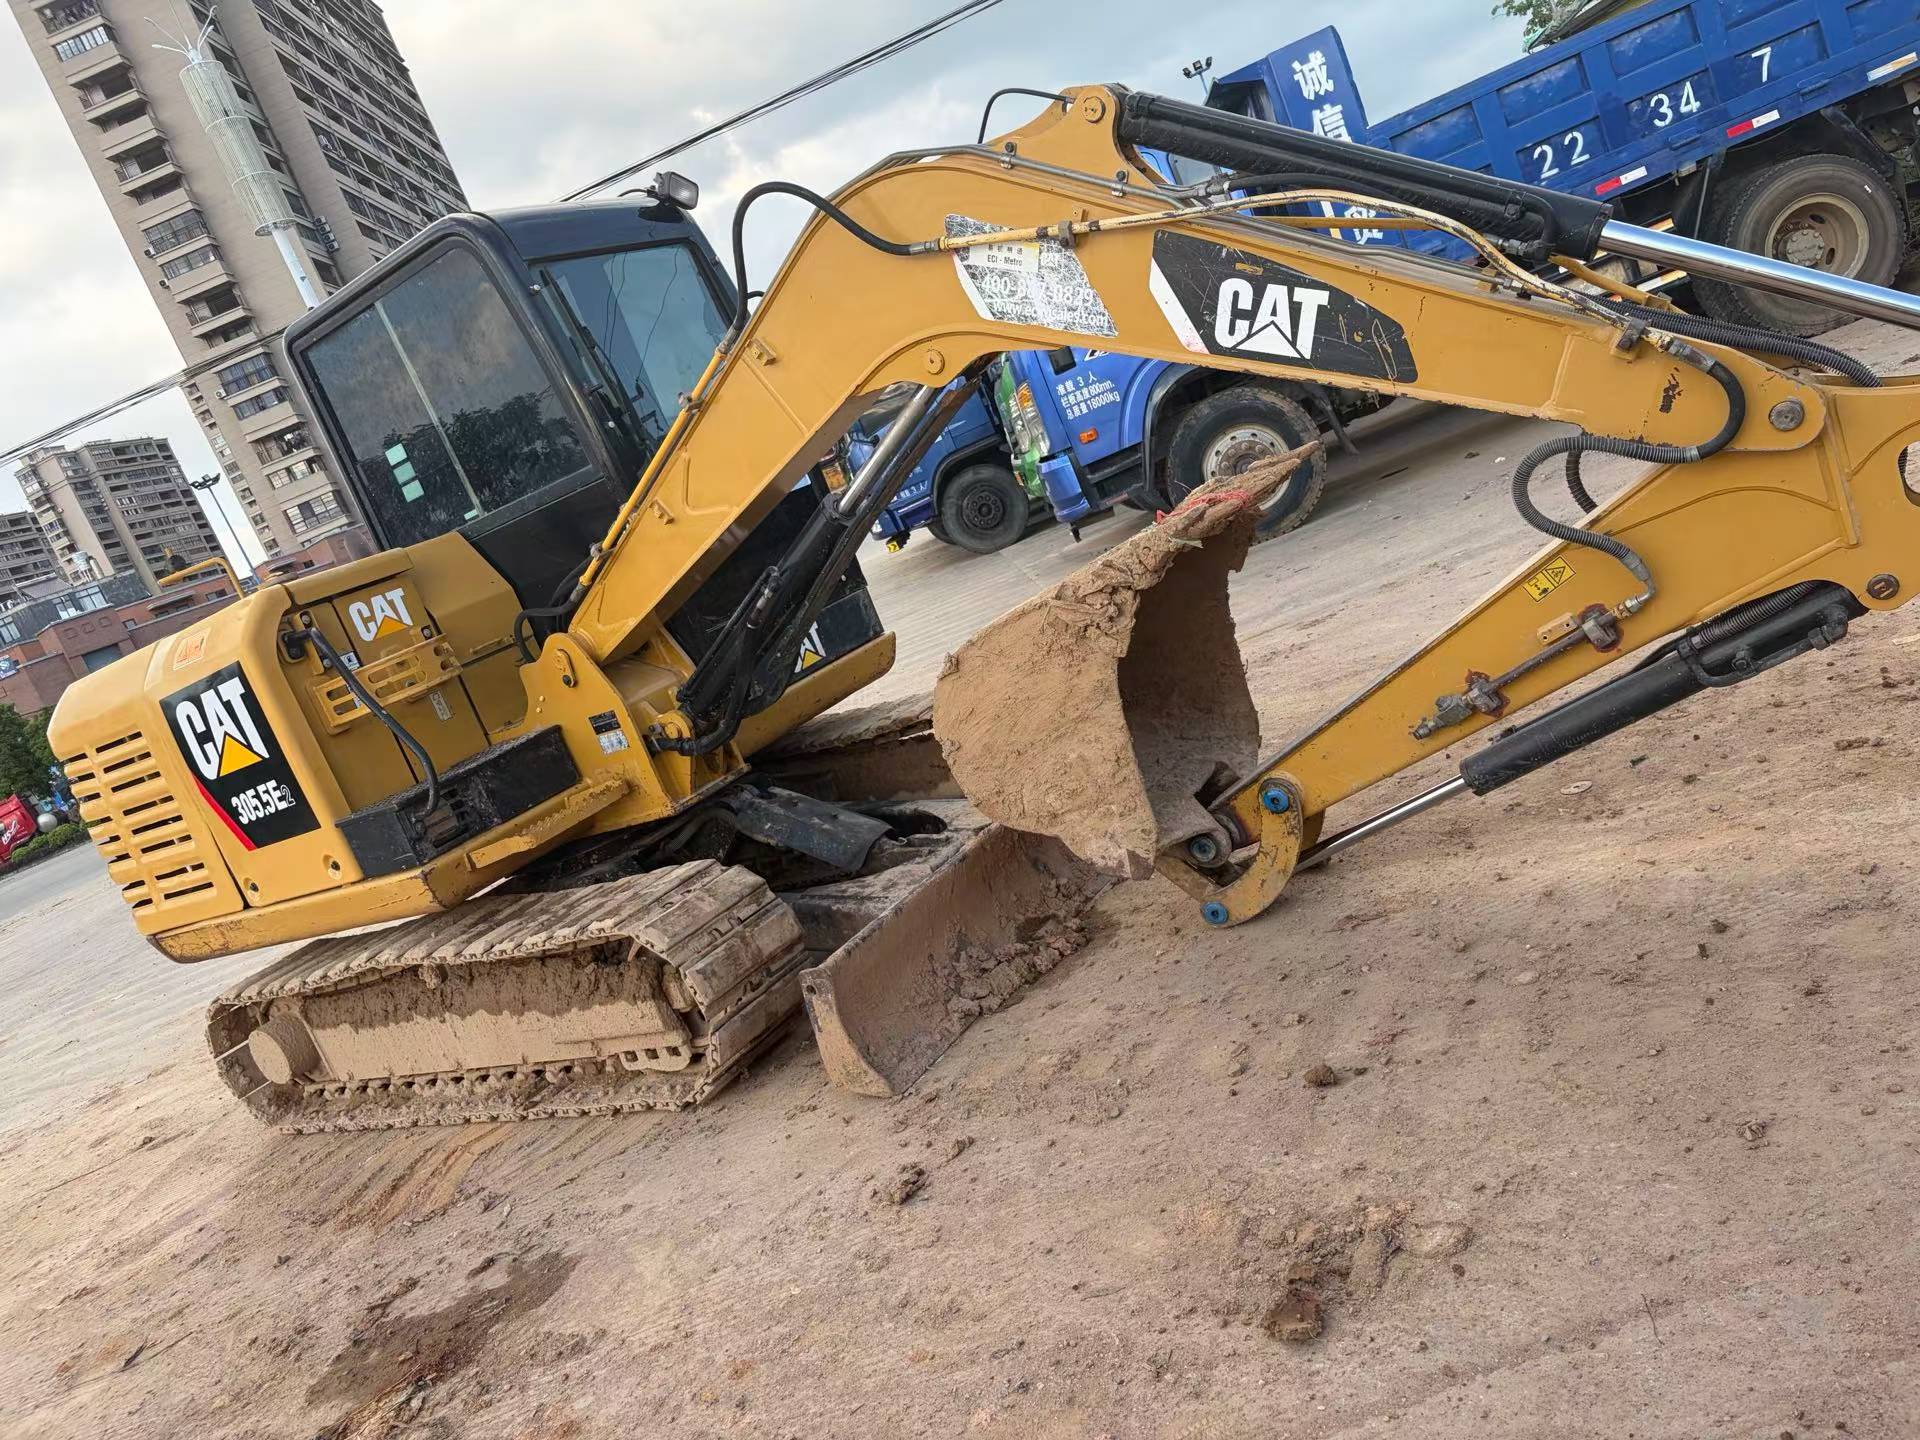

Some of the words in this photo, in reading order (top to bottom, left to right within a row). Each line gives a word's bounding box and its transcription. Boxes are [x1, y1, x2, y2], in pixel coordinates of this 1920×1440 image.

[1215, 278, 1330, 360] CAT
[348, 587, 414, 642] CAT
[794, 620, 827, 673] AT
[175, 676, 270, 781] CAT
